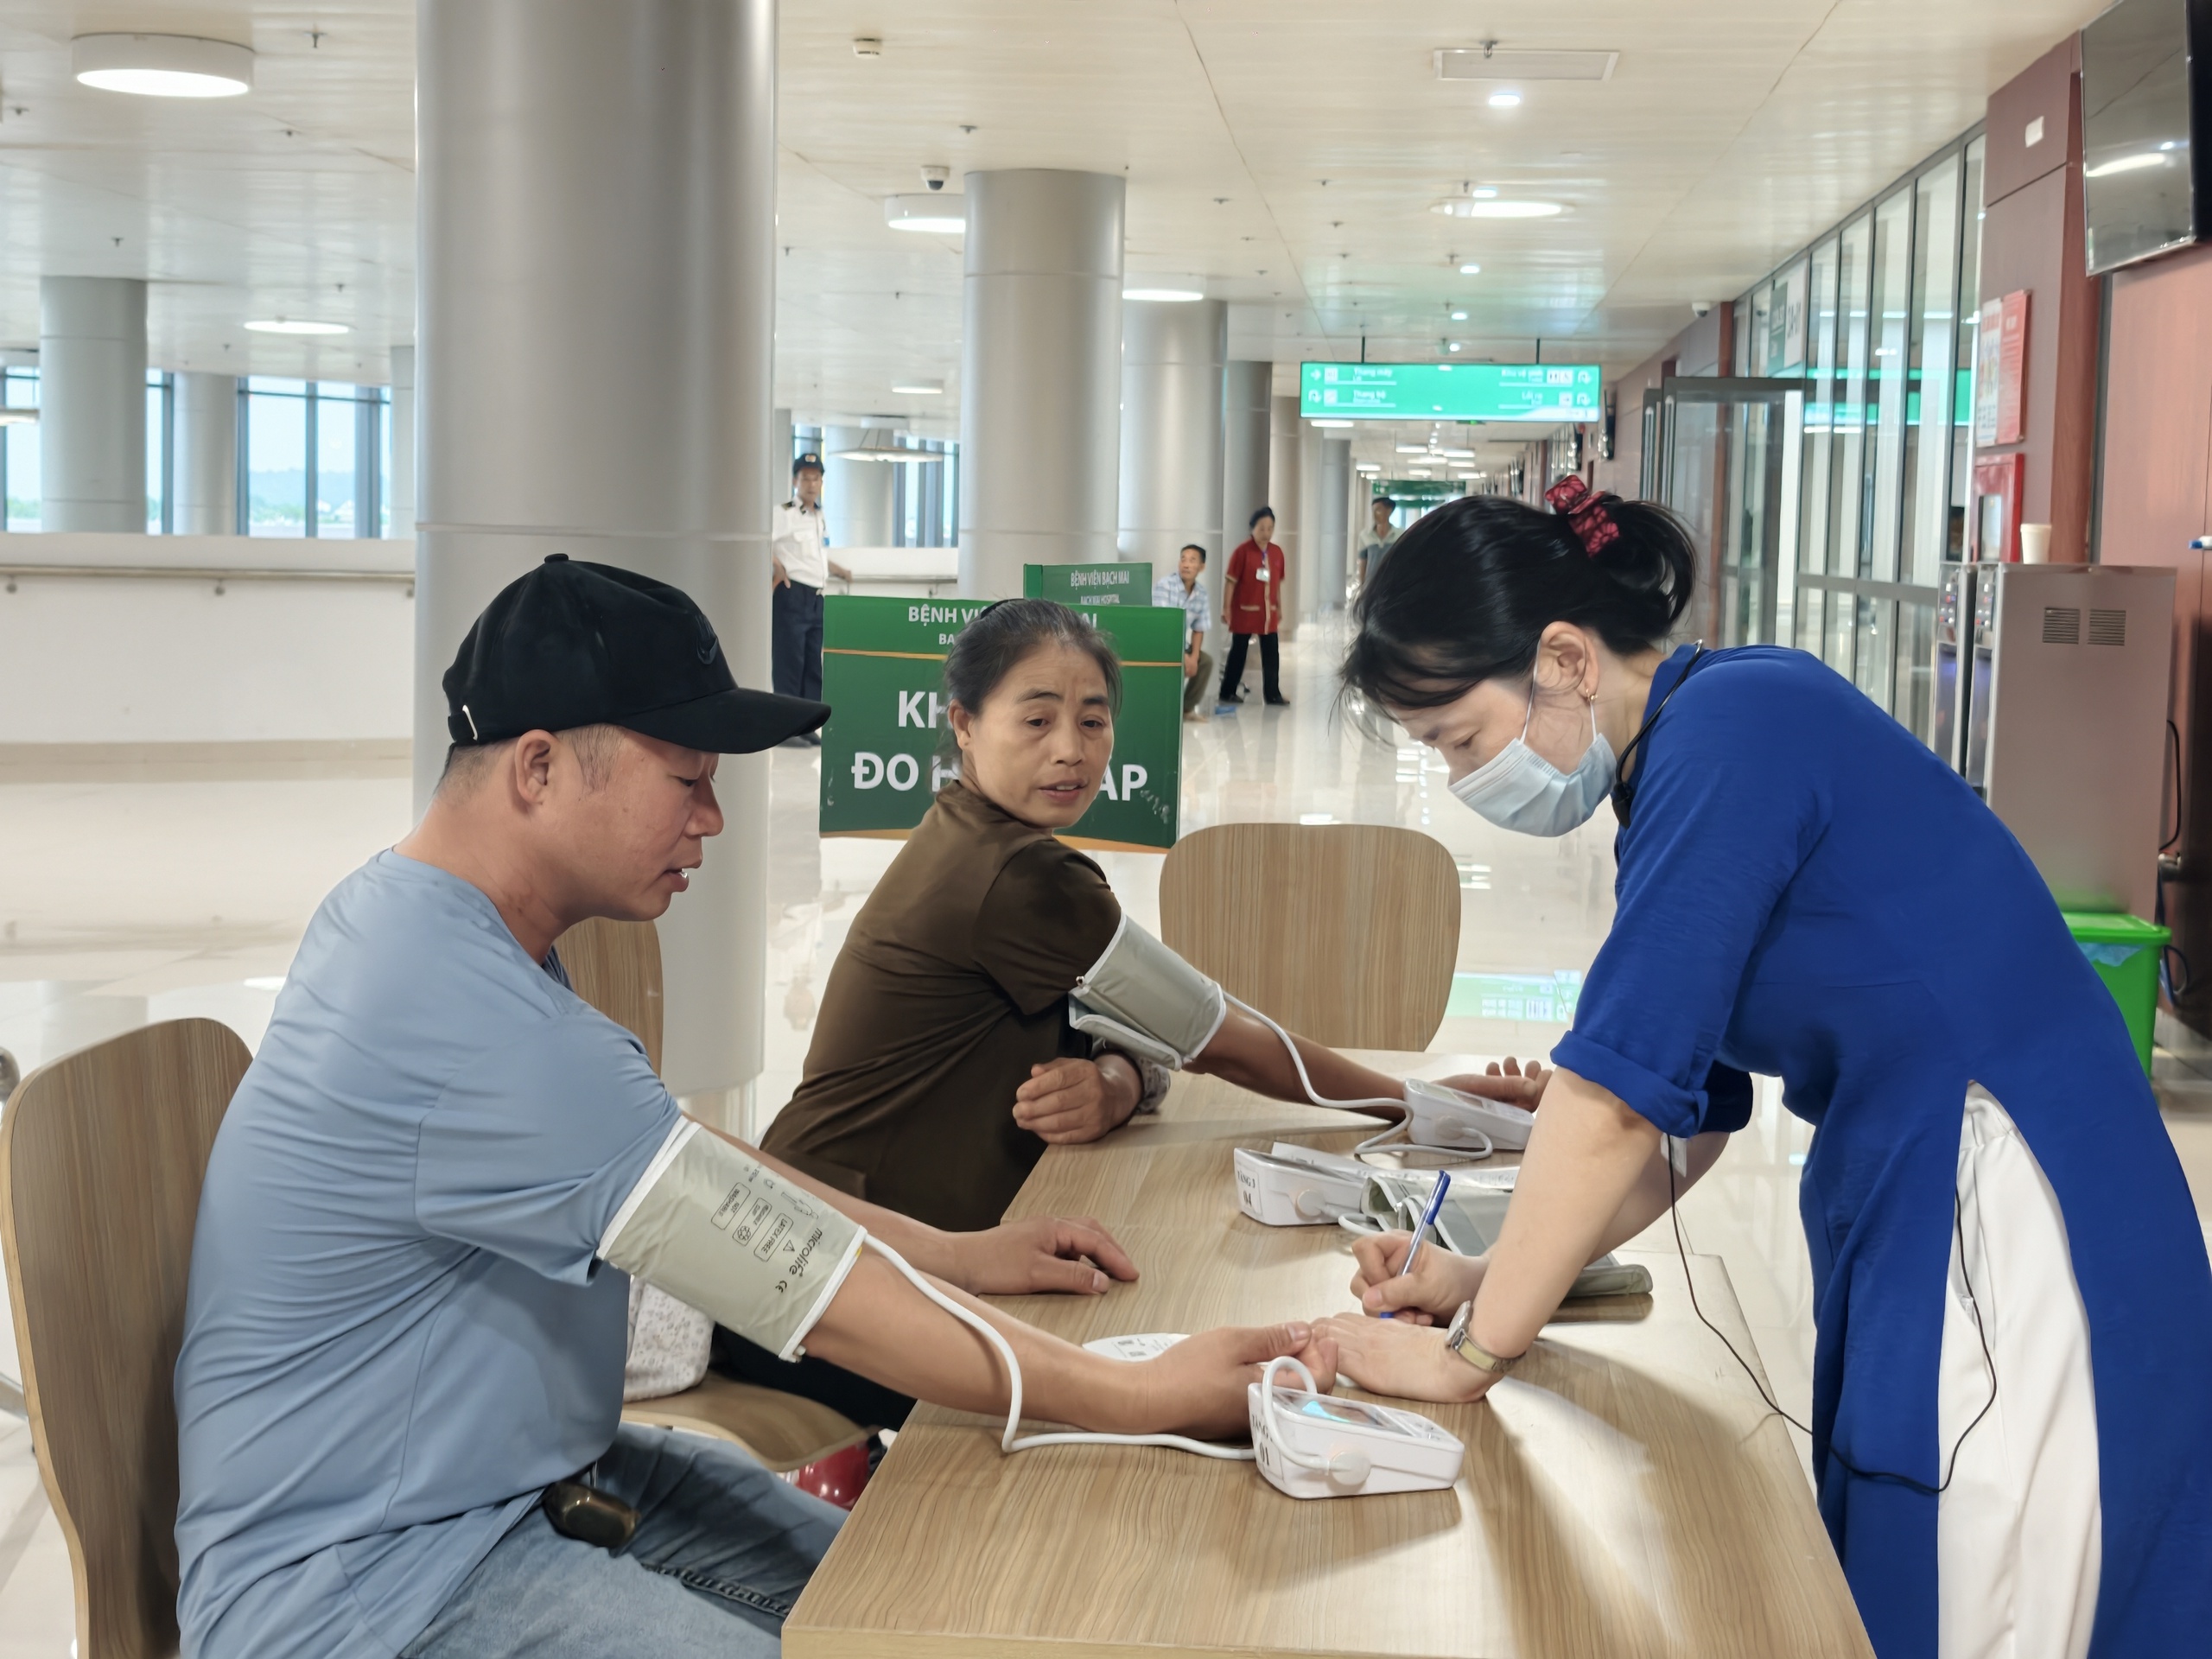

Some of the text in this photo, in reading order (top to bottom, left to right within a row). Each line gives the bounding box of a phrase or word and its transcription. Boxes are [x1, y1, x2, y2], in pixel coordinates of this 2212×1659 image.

[1071, 569, 1129, 590] BỆNH VIỆN BẠCH MAI
[908, 603, 957, 626] BỆNH
[851, 751, 918, 791] ĐO
[761, 1218, 788, 1254] LATEX FREE
[790, 1227, 823, 1277] microlife
